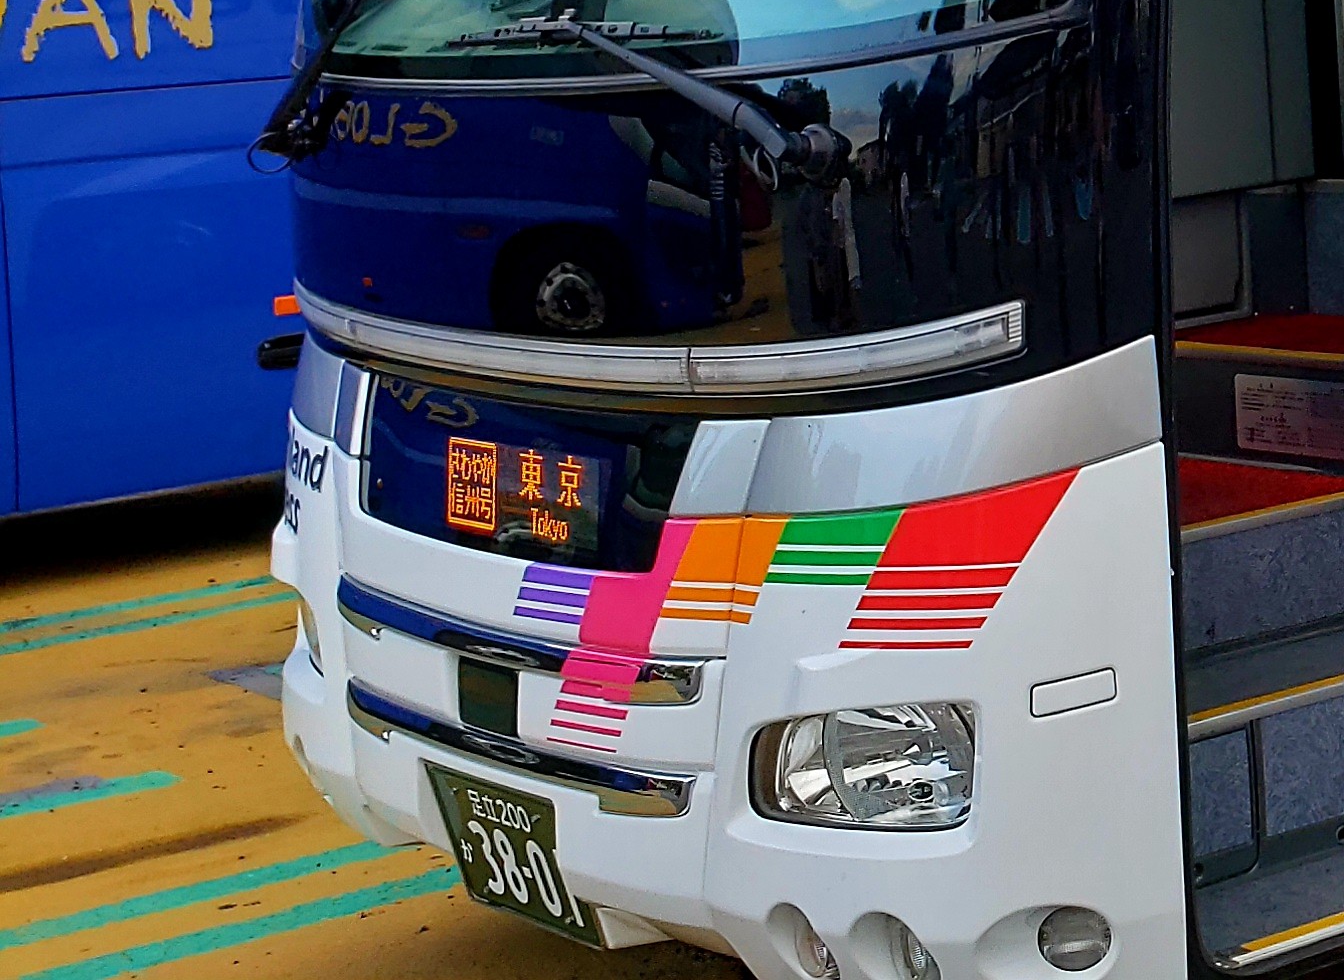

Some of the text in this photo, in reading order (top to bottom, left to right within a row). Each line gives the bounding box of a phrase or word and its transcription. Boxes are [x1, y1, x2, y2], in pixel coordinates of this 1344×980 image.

[518, 448, 584, 508] 東京
[451, 481, 493, 520] 信州号
[530, 506, 570, 542] Tokyo
[467, 789, 531, 833] 足立200
[467, 820, 585, 928] 38-01
